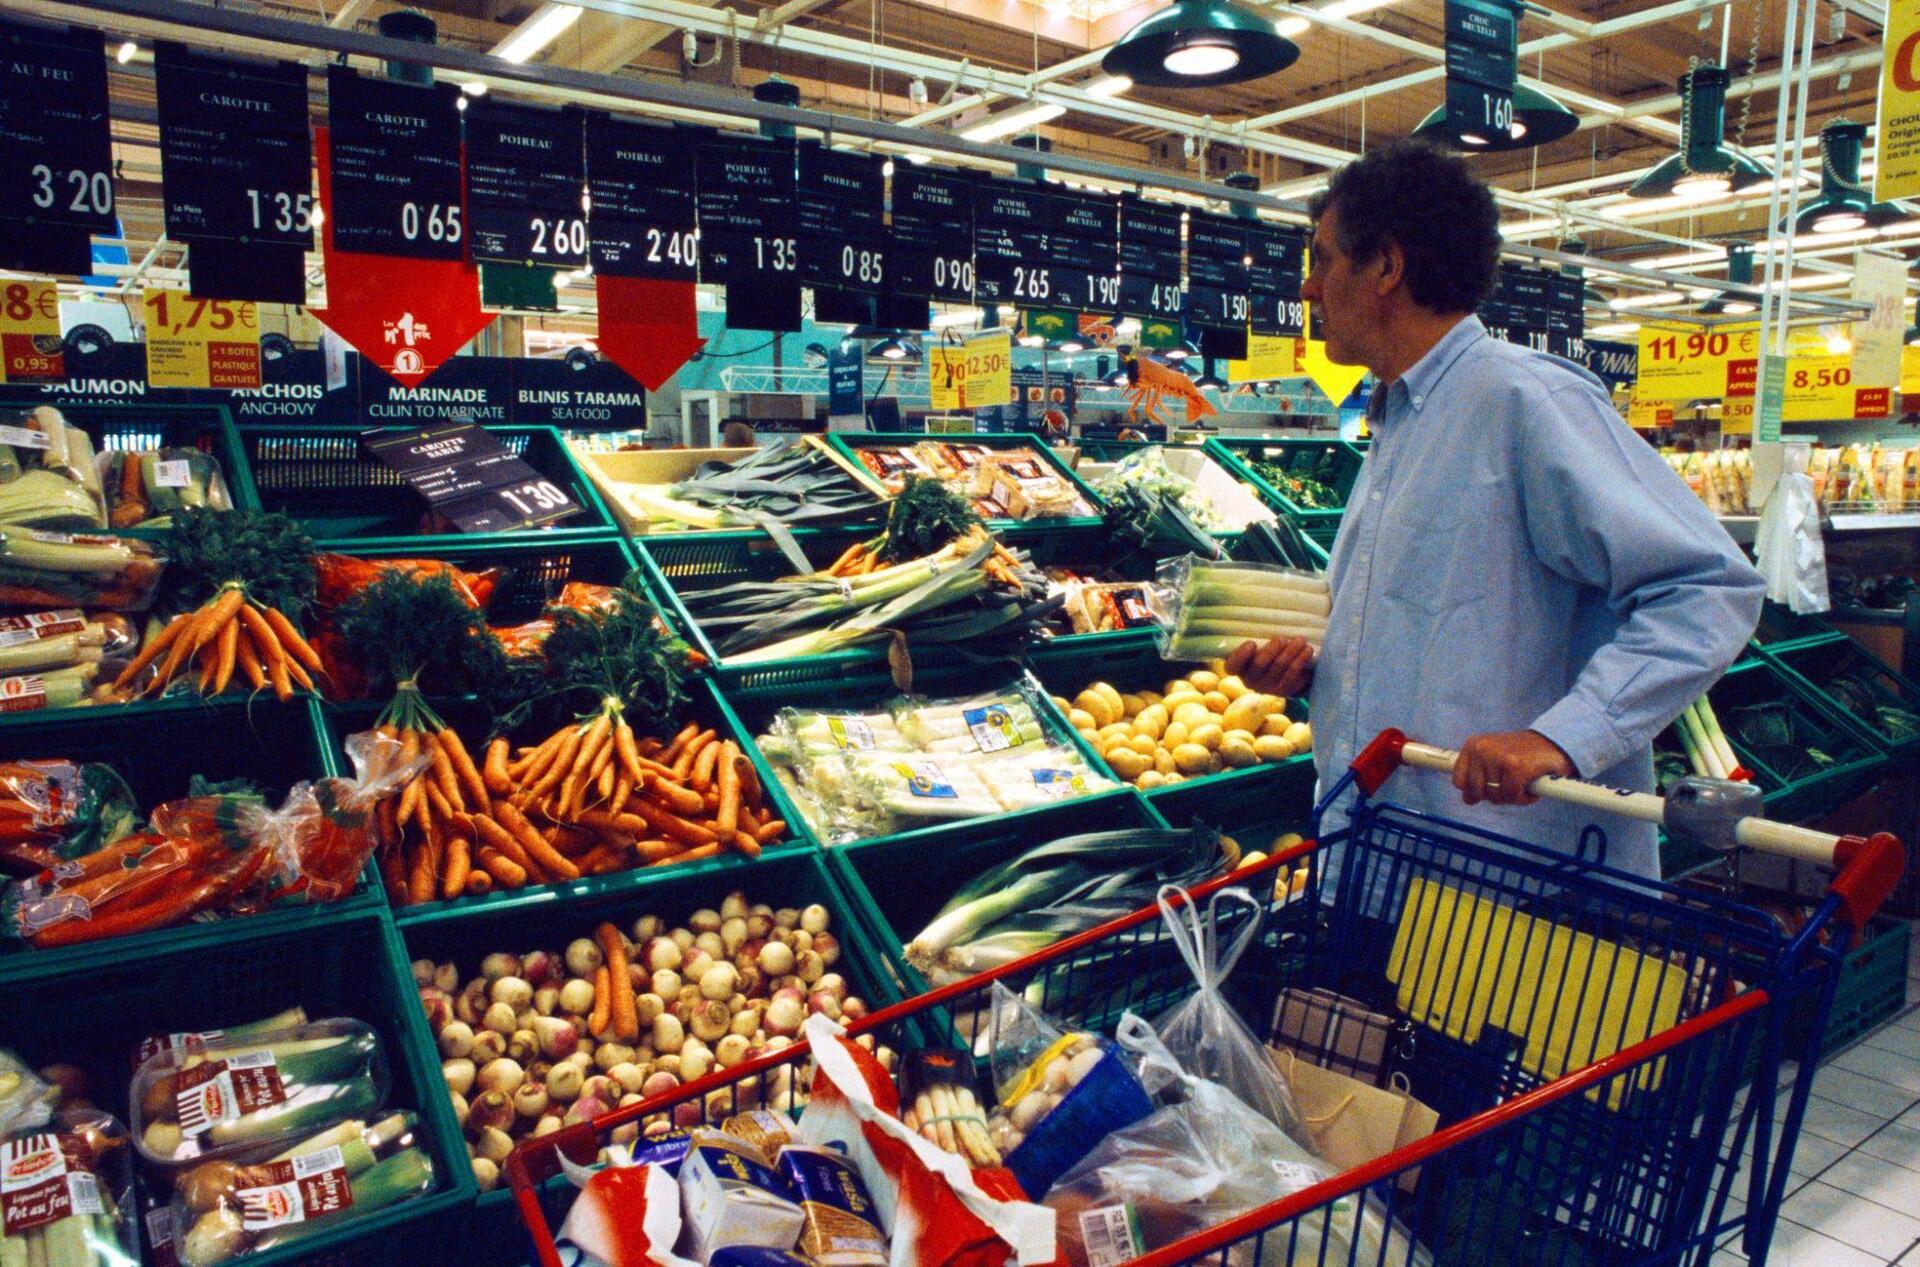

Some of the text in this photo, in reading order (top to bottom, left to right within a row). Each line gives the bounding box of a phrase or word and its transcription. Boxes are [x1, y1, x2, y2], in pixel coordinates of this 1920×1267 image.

[11, 62, 73, 82] AU FEU
[199, 91, 272, 113] CAROTTE
[364, 111, 428, 128] CAROTTE
[499, 133, 552, 150] POIREAU
[616, 149, 664, 164] POIREAU
[725, 163, 769, 176] POIREAU
[823, 173, 862, 190] POIREAU
[918, 183, 949, 196] POMME
[912, 192, 953, 206] DE TERRE
[997, 197, 1027, 209] POMME
[993, 205, 1031, 217] DE TERRE
[1646, 331, 1754, 364] 11,90 €
[212, 361, 256, 371] PLASTIQUE
[41, 377, 145, 395] SAUMON
[213, 374, 256, 384] GRATUITE
[1793, 367, 1851, 391] 8,50
[230, 384, 323, 399] ANCHOIS
[388, 387, 488, 403] MARINADE
[518, 389, 642, 406] BLINIS TARAMA
[239, 402, 316, 416] ANCHOVY
[369, 404, 506, 419] CULIN TO MARINATE
[551, 407, 611, 421] SEA FOOD
[1722, 404, 1754, 417] 8,50
[410, 436, 467, 455] CAROTTE
[425, 445, 465, 459] SABLE
[7, 1194, 69, 1222] Pot au feu
